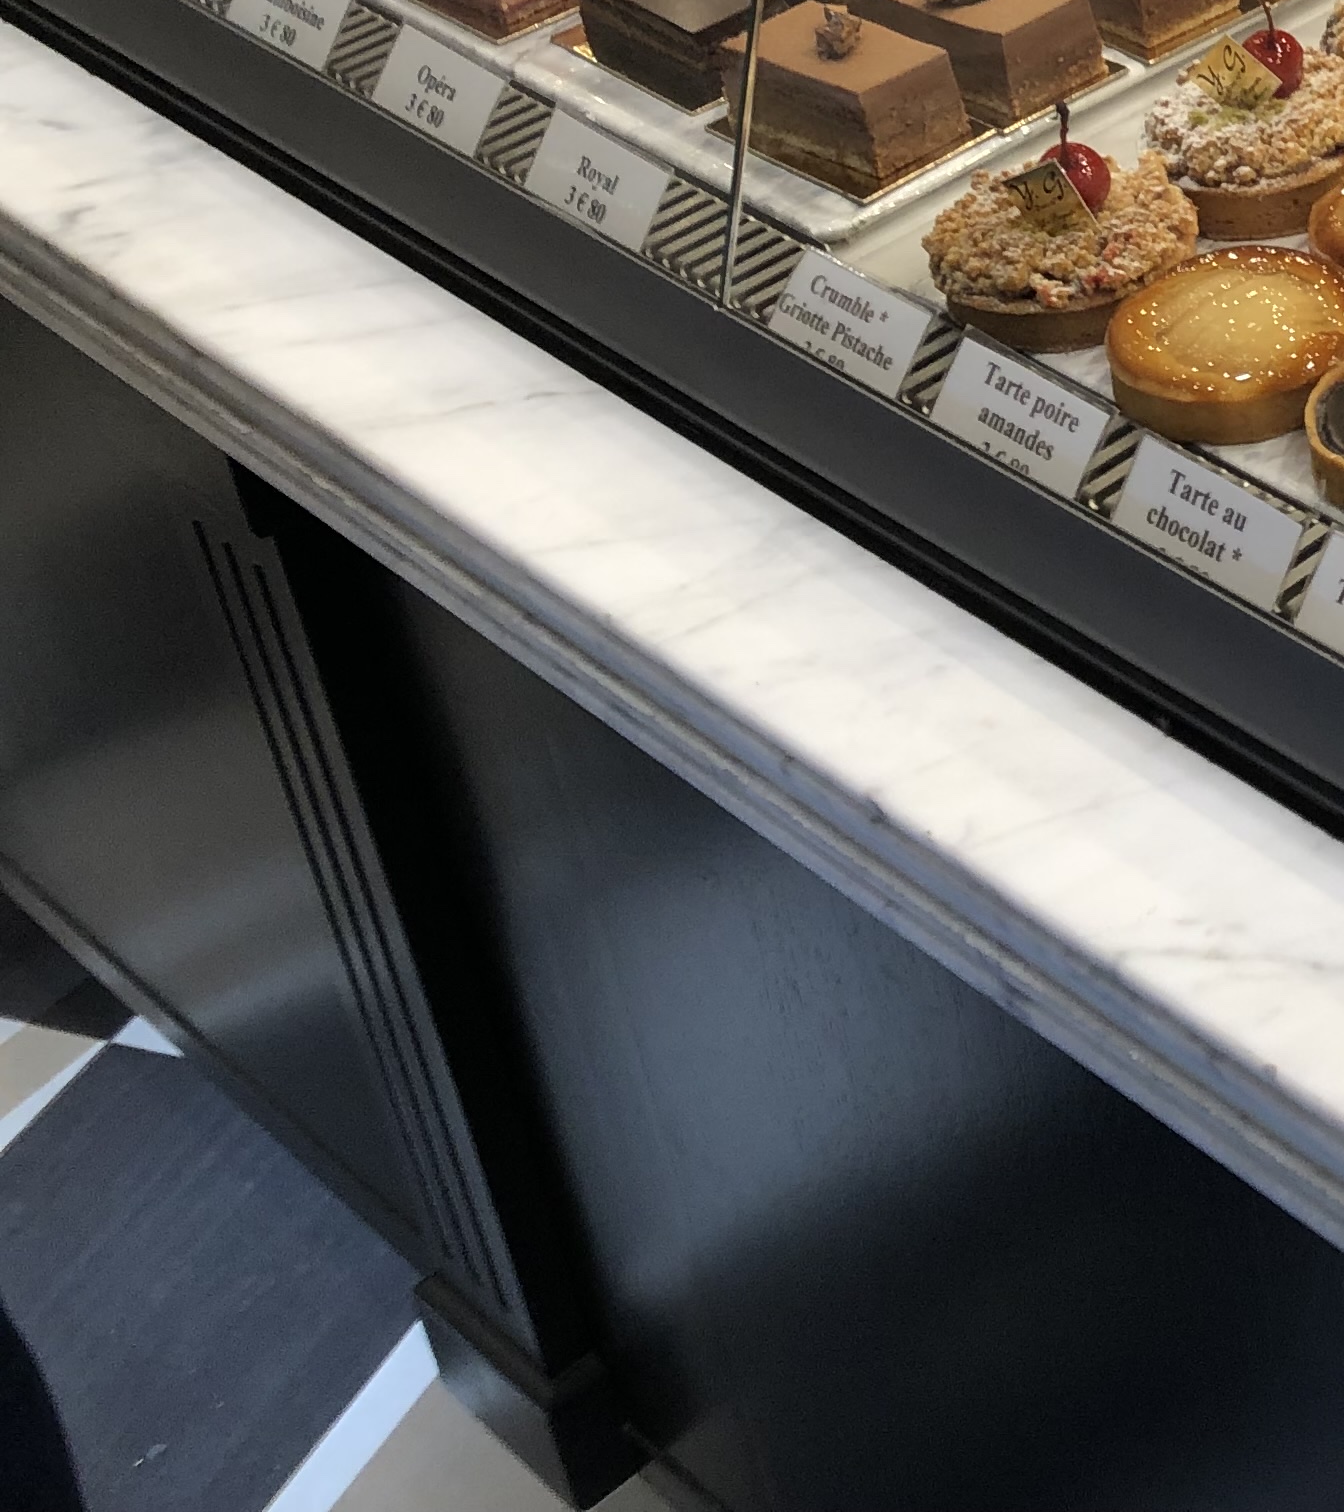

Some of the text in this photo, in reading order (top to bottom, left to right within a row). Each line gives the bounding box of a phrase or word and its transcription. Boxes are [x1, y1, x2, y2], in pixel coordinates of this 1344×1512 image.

[259, 14, 296, 47] 3 € 80
[416, 64, 456, 102] Opéra
[405, 93, 444, 128] 3 € 80
[576, 155, 620, 196] Royal
[564, 185, 606, 224] 3 € 80
[809, 275, 874, 324] Crumble
[779, 292, 830, 336] Griotte
[831, 321, 893, 371] Pistache
[984, 361, 1080, 434] Tarte poire
[977, 406, 1055, 462] amandes
[1168, 468, 1249, 533] Tarte au
[1146, 506, 1227, 563] chocolat
